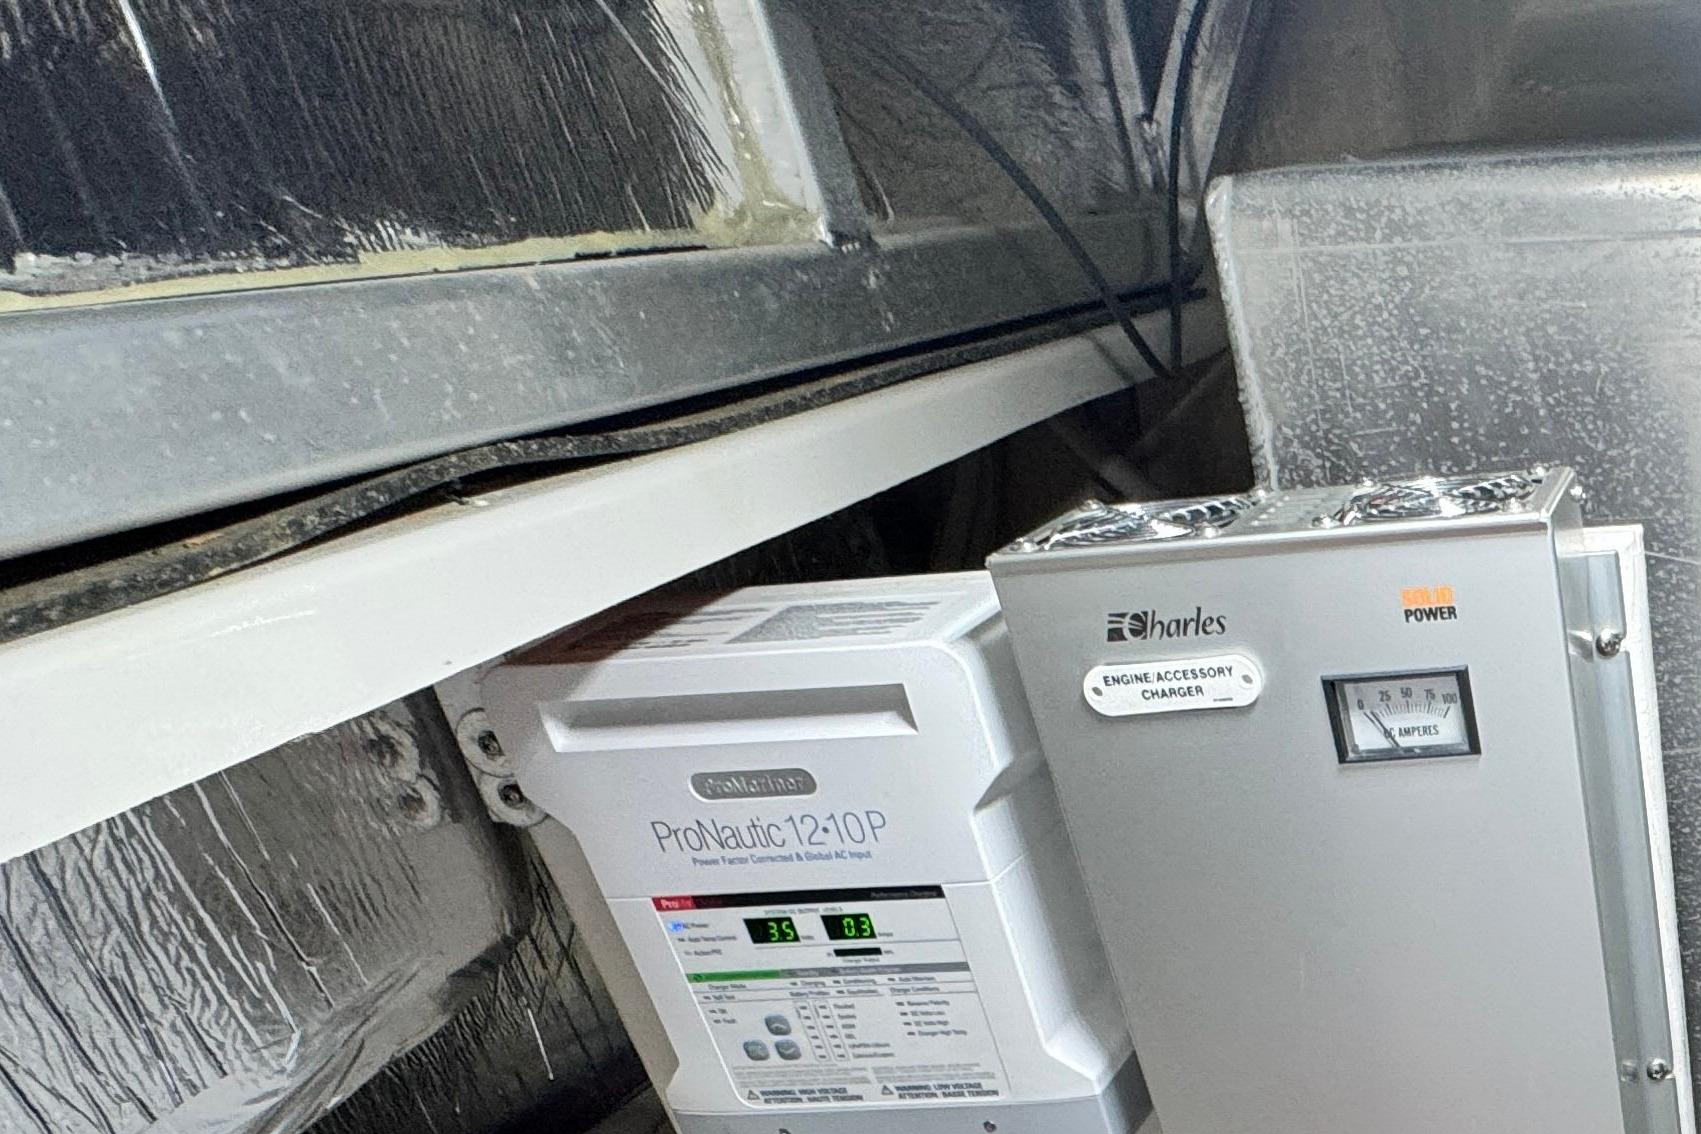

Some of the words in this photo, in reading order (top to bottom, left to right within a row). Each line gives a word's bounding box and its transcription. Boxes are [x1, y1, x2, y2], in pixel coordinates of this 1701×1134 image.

[1404, 606, 1458, 623] POWER
[1107, 606, 1227, 642] Charles
[1103, 665, 1233, 687] ENGINE/ACCESSORY
[1141, 685, 1204, 701] CHARGER
[1378, 689, 1392, 702] 25
[1400, 687, 1413, 699] 50
[1423, 688, 1436, 701] 75
[1441, 693, 1458, 705] 100
[1356, 698, 1365, 711] 0
[1398, 725, 1440, 738] AMPERES
[651, 817, 786, 853] ProNautic
[692, 856, 720, 867] Power
[834, 850, 848, 860] AC
